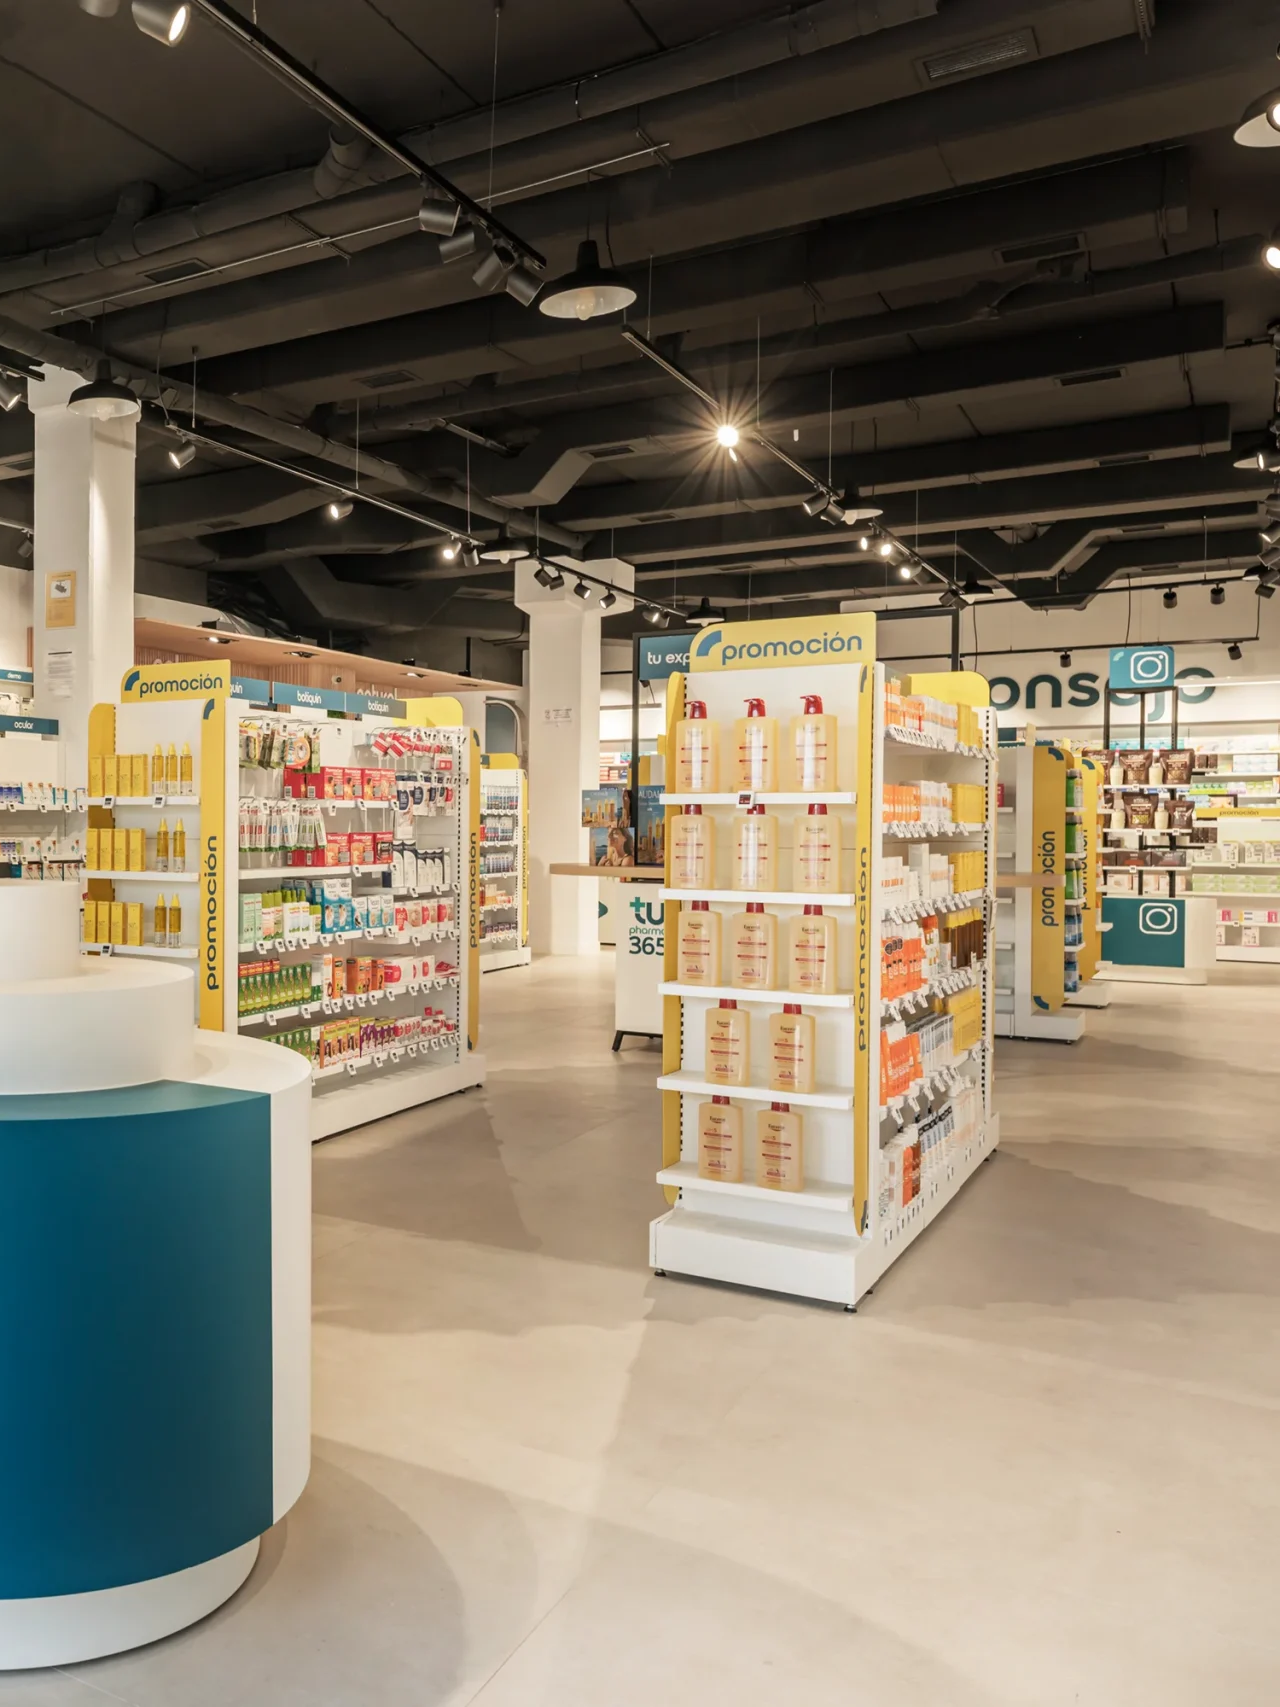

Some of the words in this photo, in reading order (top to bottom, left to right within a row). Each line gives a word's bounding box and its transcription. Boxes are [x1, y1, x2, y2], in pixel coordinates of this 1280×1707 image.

[647, 651, 662, 665] tu
[722, 632, 863, 666] promoción
[140, 674, 223, 698] promoción
[14, 720, 34, 730] ocular
[1219, 809, 1259, 817] promoción
[469, 832, 478, 949] promoción
[204, 836, 219, 990] promoción
[629, 896, 665, 925] tu
[629, 936, 664, 956] 365
[858, 847, 867, 1052] promoción
